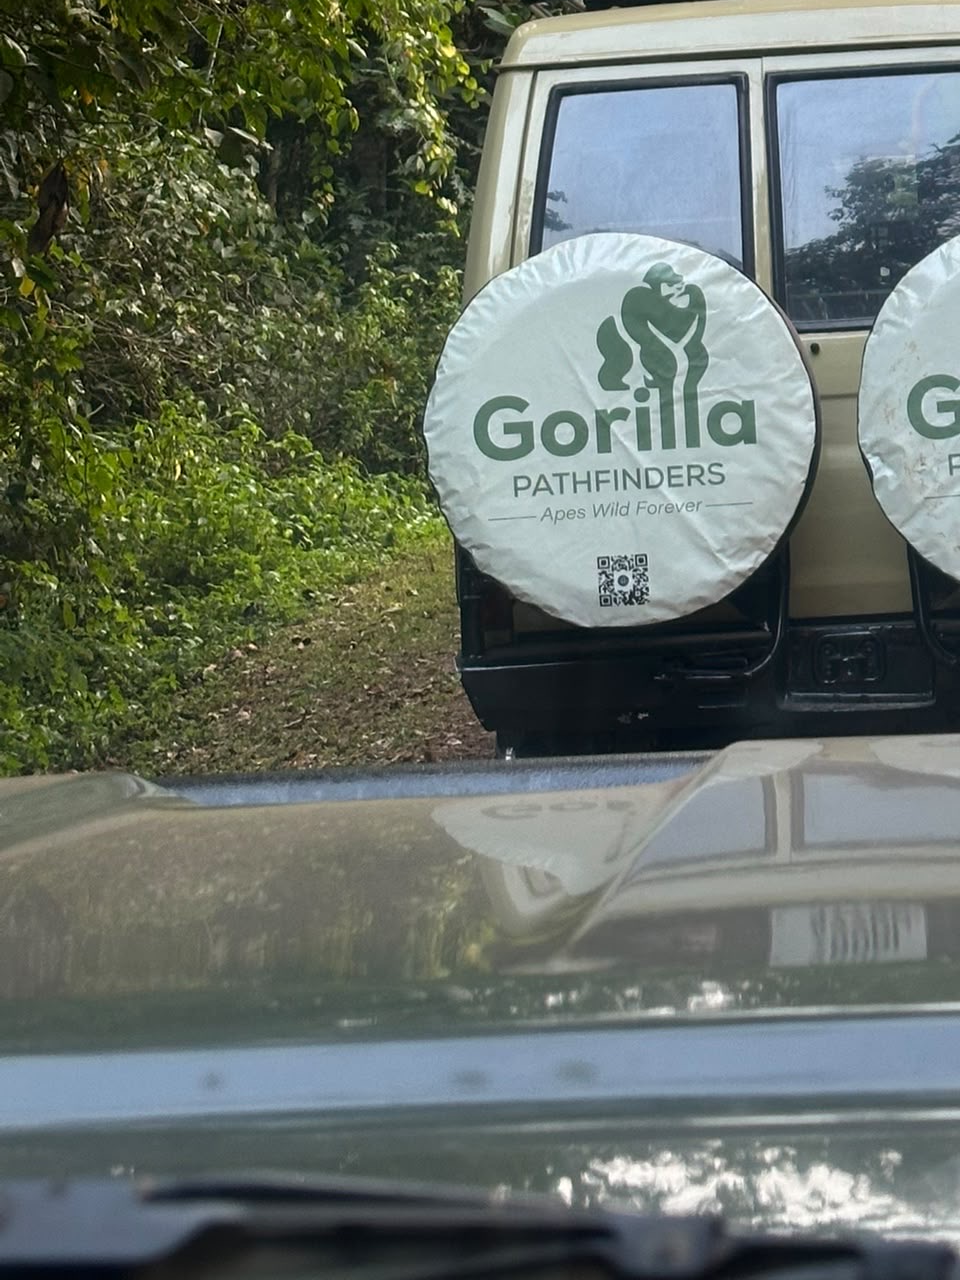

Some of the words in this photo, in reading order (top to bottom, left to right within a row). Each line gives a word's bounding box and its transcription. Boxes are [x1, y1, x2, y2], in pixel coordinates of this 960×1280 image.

[473, 387, 758, 462] Gorilla
[512, 462, 726, 498] PATHFINDERS
[540, 506, 586, 524] Apes
[592, 502, 630, 519] Wild
[636, 500, 703, 516] Forever
